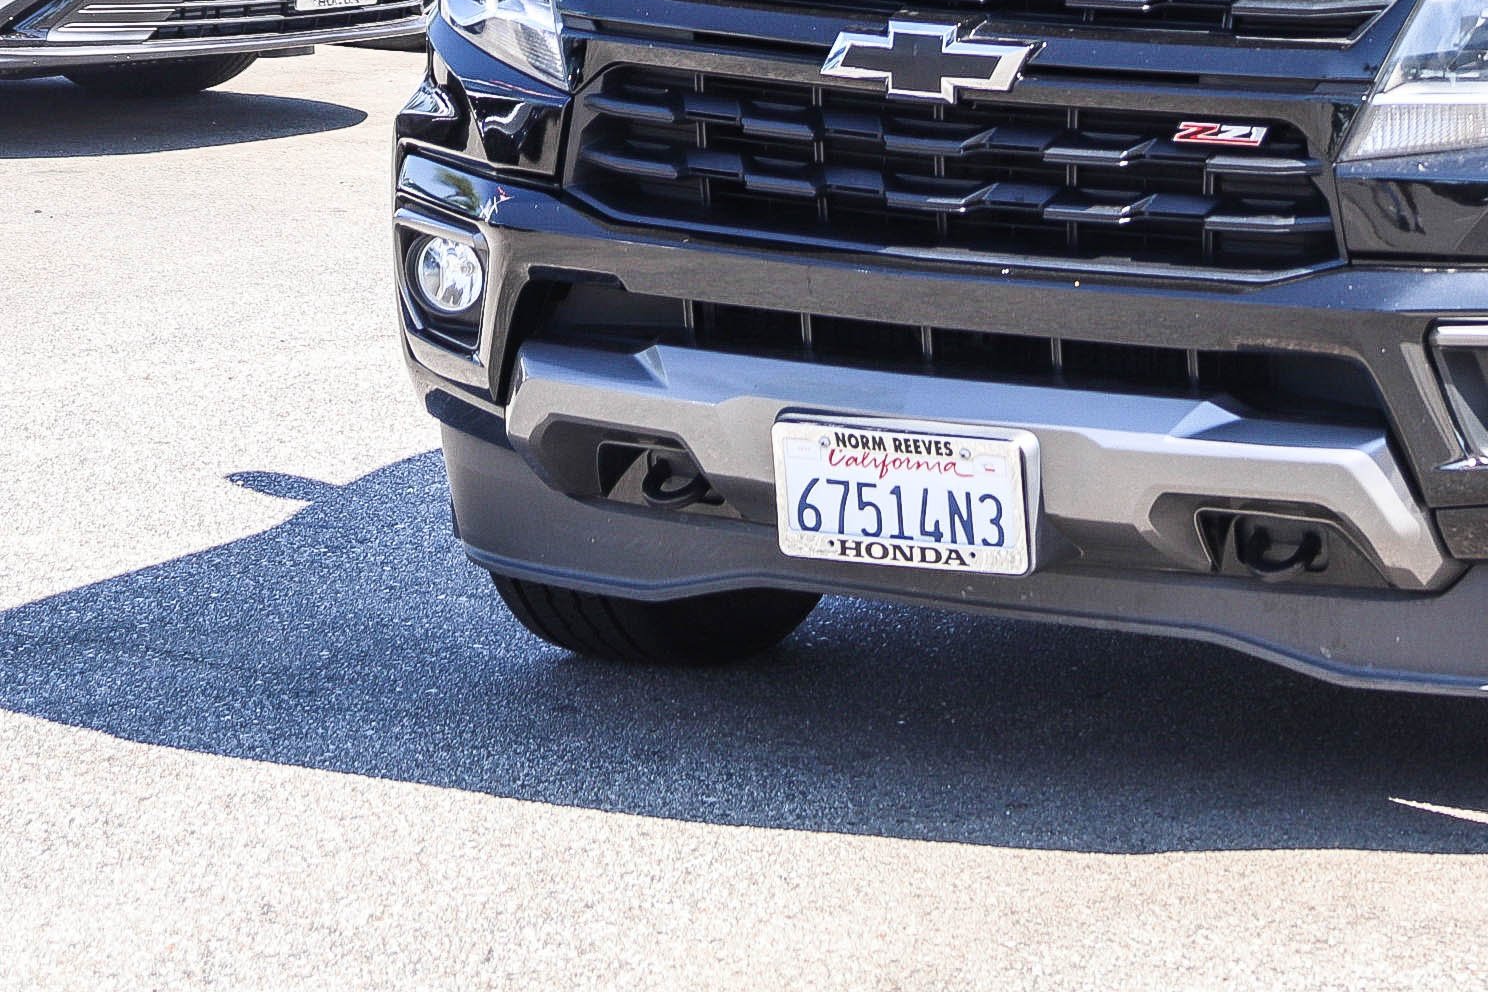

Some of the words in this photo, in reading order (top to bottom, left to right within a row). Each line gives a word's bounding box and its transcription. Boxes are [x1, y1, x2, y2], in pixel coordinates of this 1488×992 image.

[834, 431, 887, 453] NORM
[894, 438, 954, 457] REEVES
[828, 448, 974, 480] California
[797, 477, 1005, 548] 67514N3
[837, 538, 970, 567] HONDA
